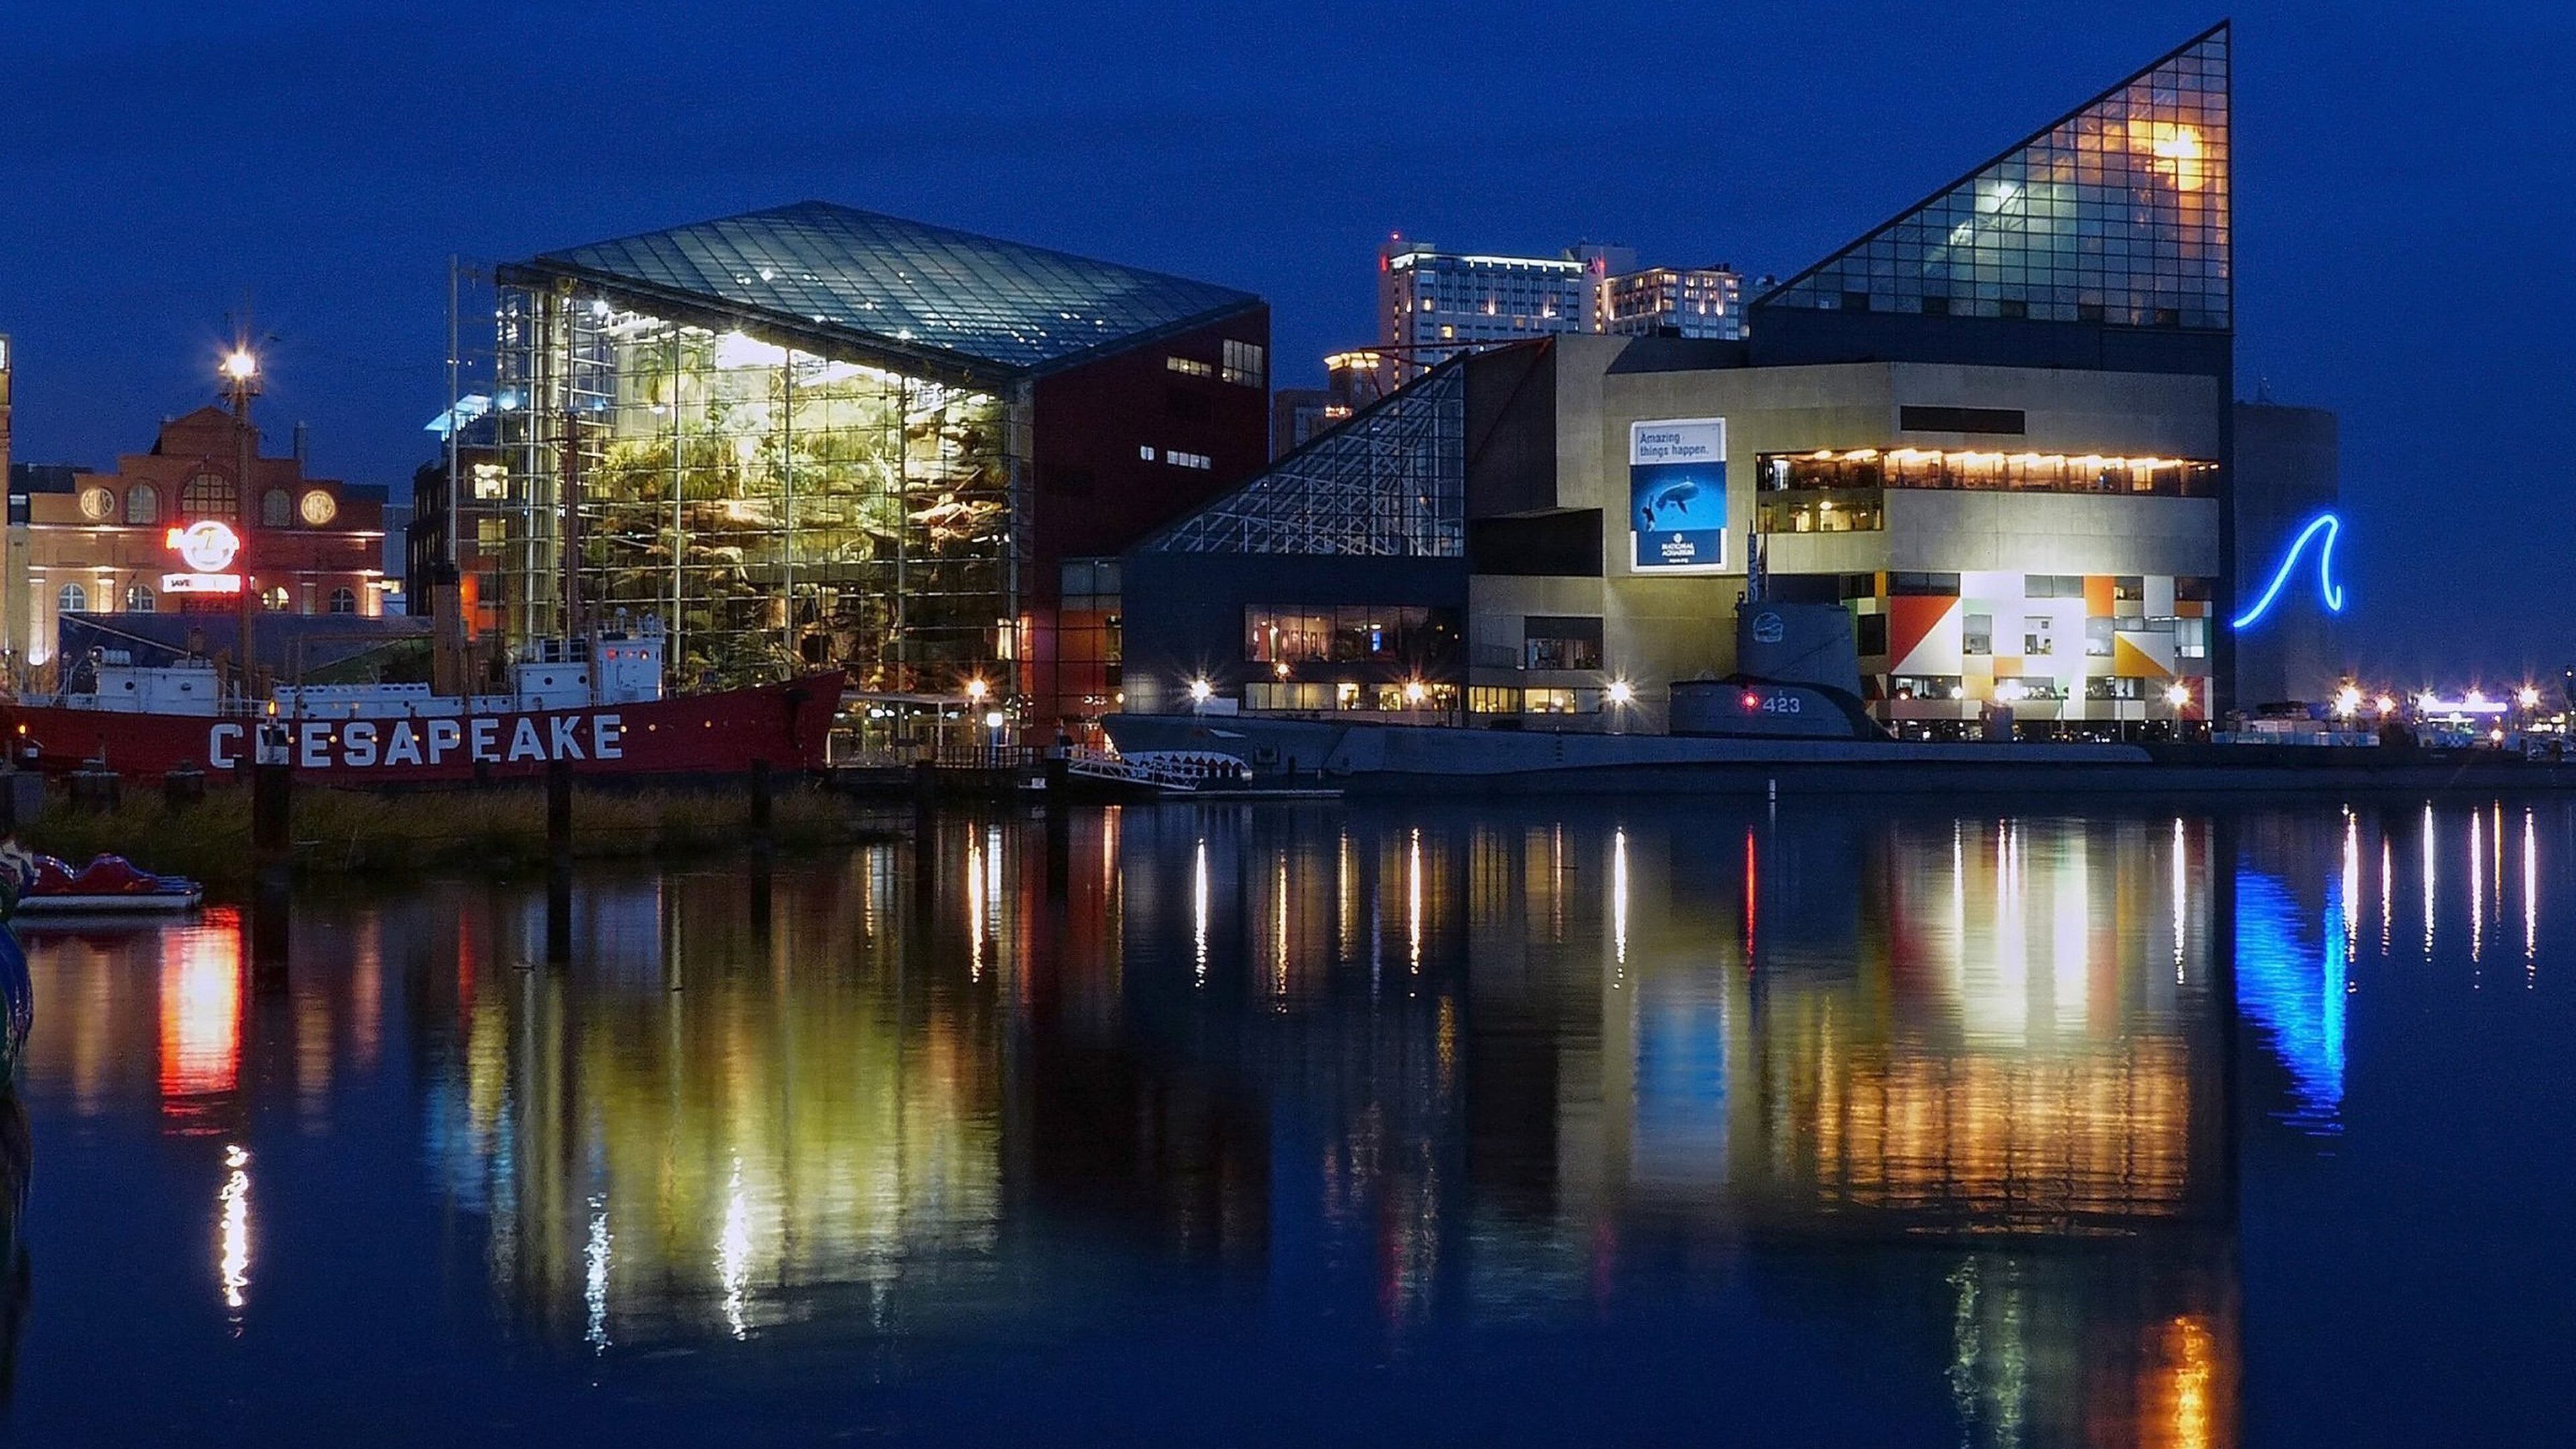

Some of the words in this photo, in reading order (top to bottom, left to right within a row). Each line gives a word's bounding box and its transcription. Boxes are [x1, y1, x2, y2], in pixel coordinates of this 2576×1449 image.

[1640, 433, 1680, 444] Amazing
[1640, 445, 1669, 458] things
[1671, 445, 1709, 457] happen.
[1762, 697, 1801, 713] 423
